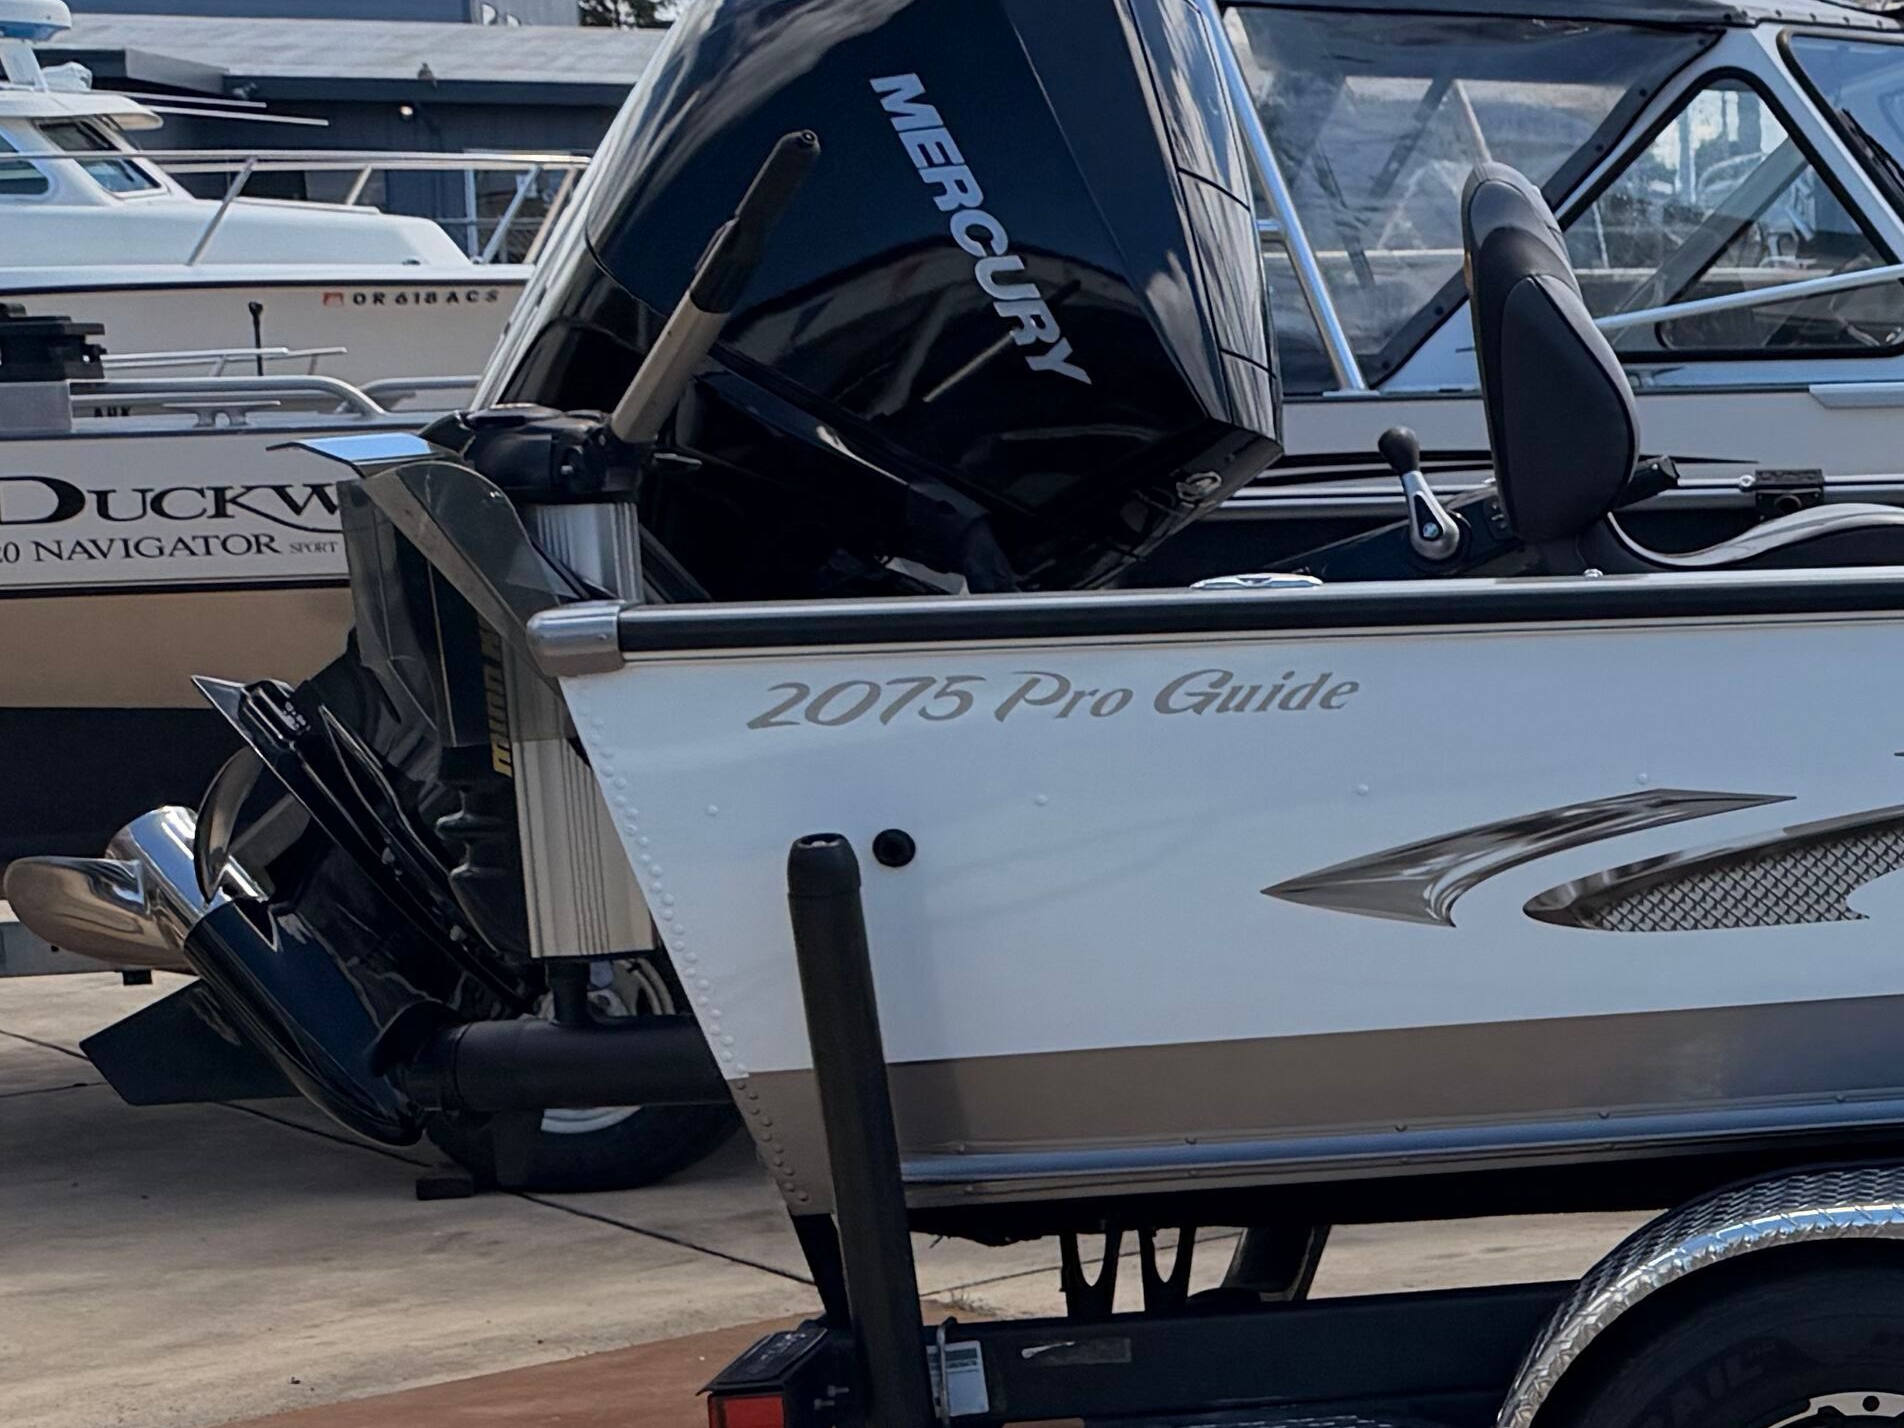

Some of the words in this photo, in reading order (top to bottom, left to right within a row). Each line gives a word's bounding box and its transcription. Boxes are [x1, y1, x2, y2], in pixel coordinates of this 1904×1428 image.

[869, 72, 1092, 385] MERCURY
[352, 292, 386, 305] OR
[29, 533, 282, 563] NAVIGATOR
[289, 540, 338, 555] SPORT
[746, 675, 987, 730] 2075
[994, 670, 1134, 723] Pro
[1153, 668, 1361, 716] Guide
